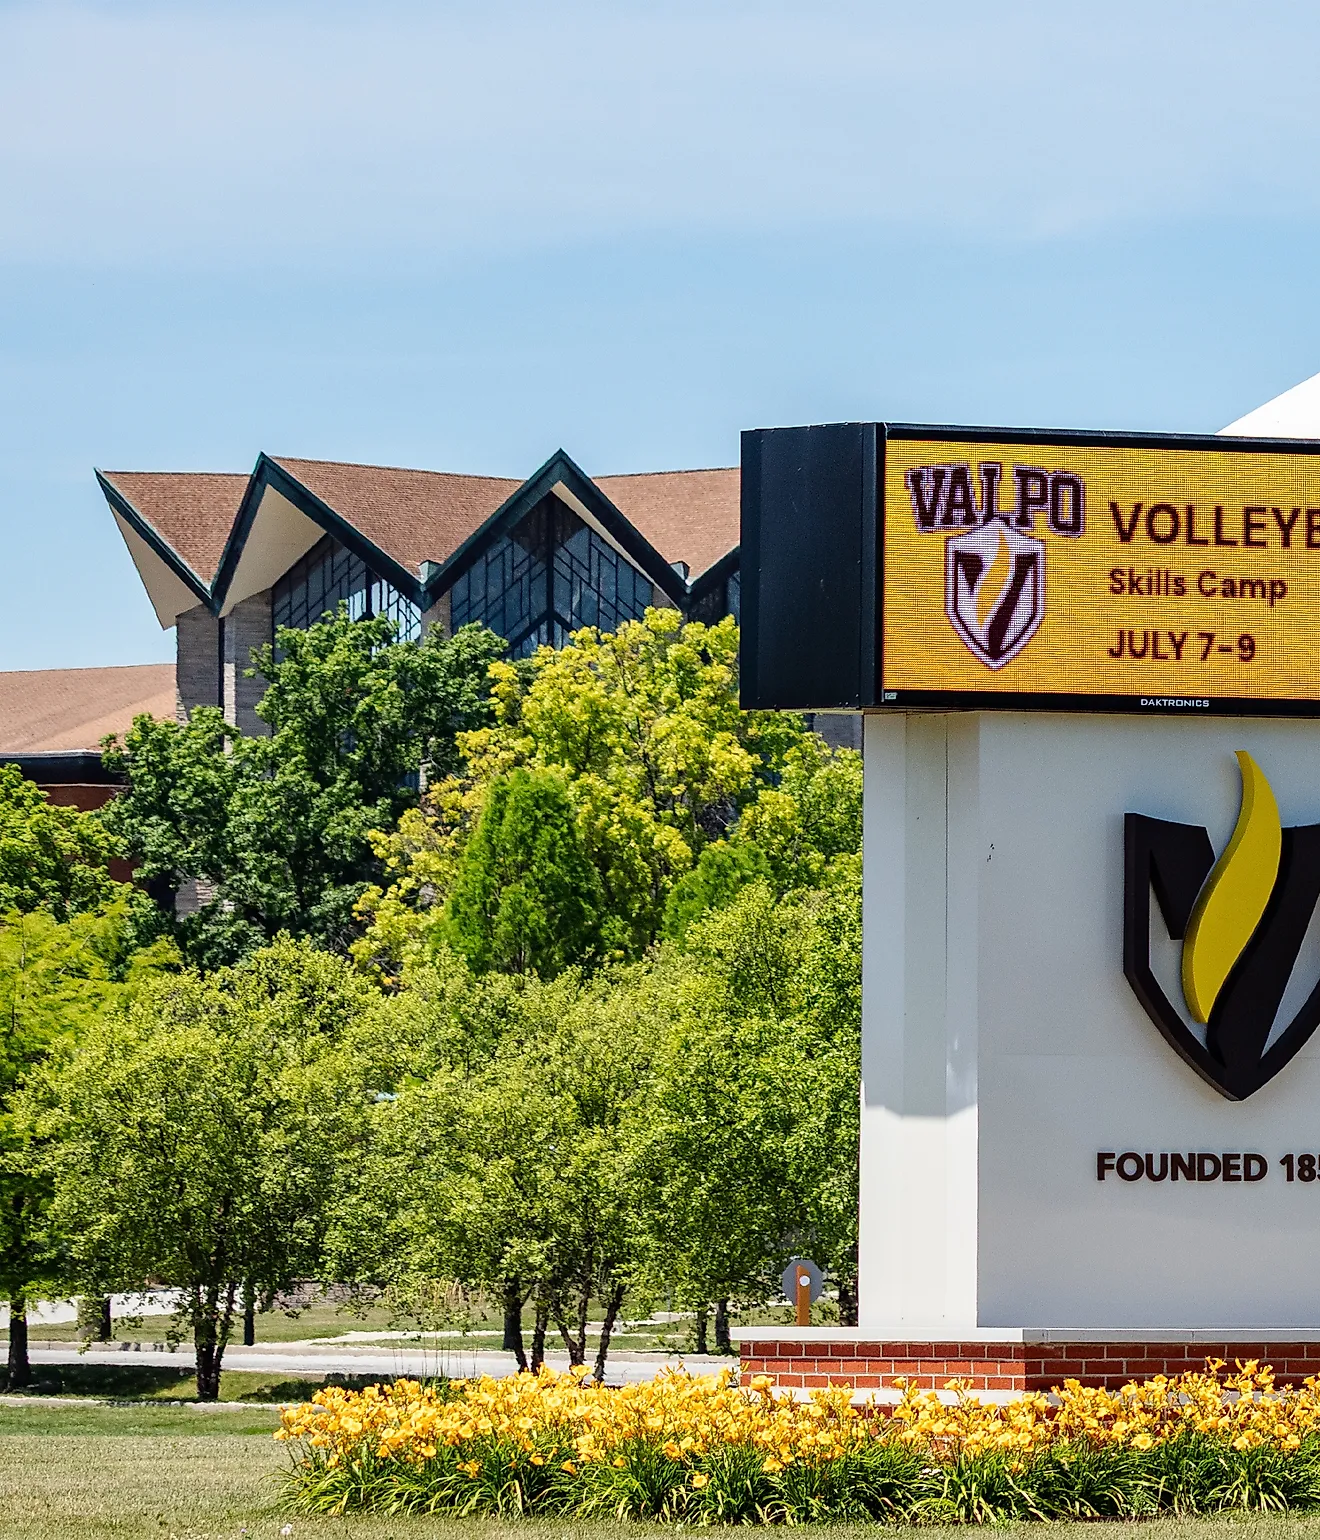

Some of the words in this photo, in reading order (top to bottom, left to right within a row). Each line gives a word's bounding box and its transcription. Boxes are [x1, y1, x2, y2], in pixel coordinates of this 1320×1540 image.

[905, 462, 1085, 537] VALPO
[1109, 567, 1187, 597] Skills
[1197, 569, 1288, 607] Camp
[1107, 630, 1188, 661] JULY
[1196, 632, 1256, 663] 7-9
[1140, 698, 1210, 708] DAKTRONICS
[1097, 1152, 1268, 1182] FOUNDED
